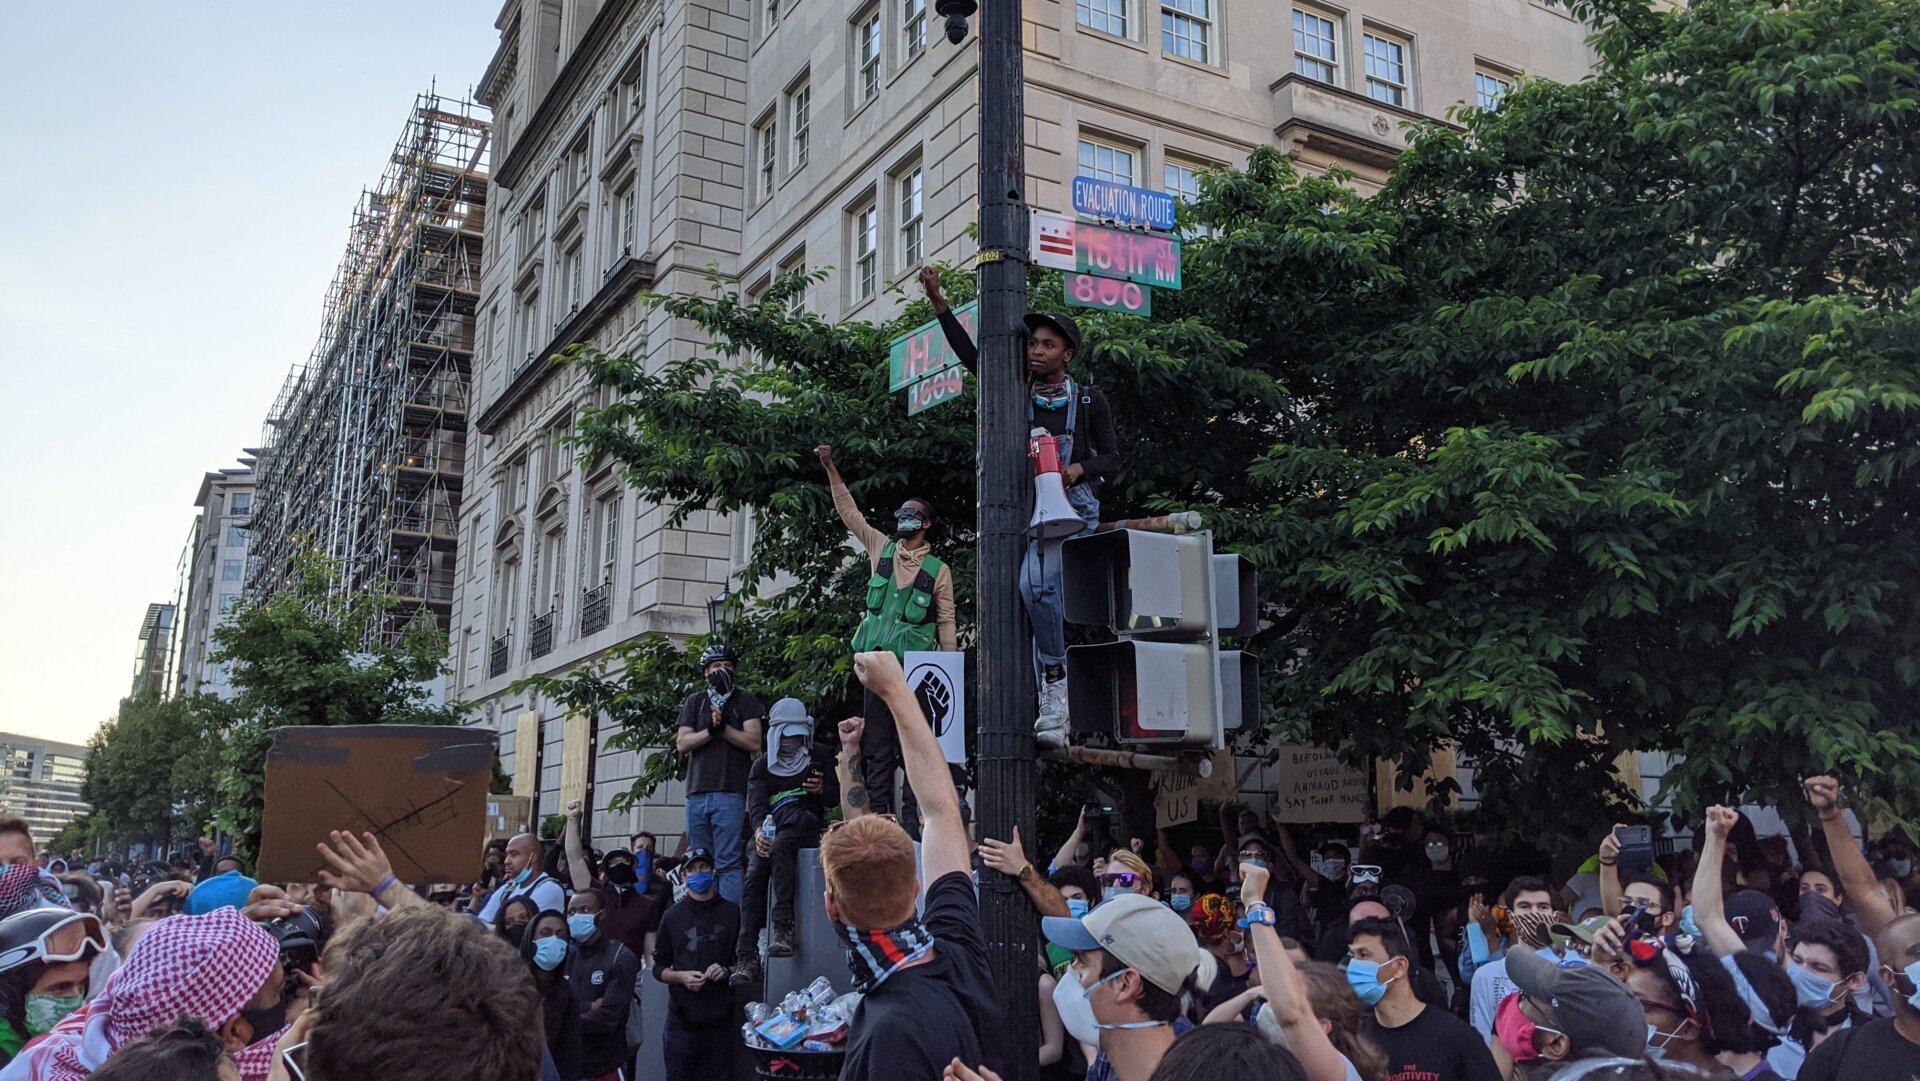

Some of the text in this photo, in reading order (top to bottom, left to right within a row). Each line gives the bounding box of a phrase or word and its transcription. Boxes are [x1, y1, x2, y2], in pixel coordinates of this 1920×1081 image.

[1076, 181, 1172, 224] EVACUATION ROUTE
[982, 251, 998, 261] 602
[1155, 260, 1176, 283] NW
[1075, 274, 1142, 310] 800
[911, 365, 961, 405] 1600
[1306, 766, 1339, 777] GEORGE
[1294, 779, 1339, 794] AHMAUD
[1167, 796, 1188, 822] US
[1284, 796, 1306, 809] SAY
